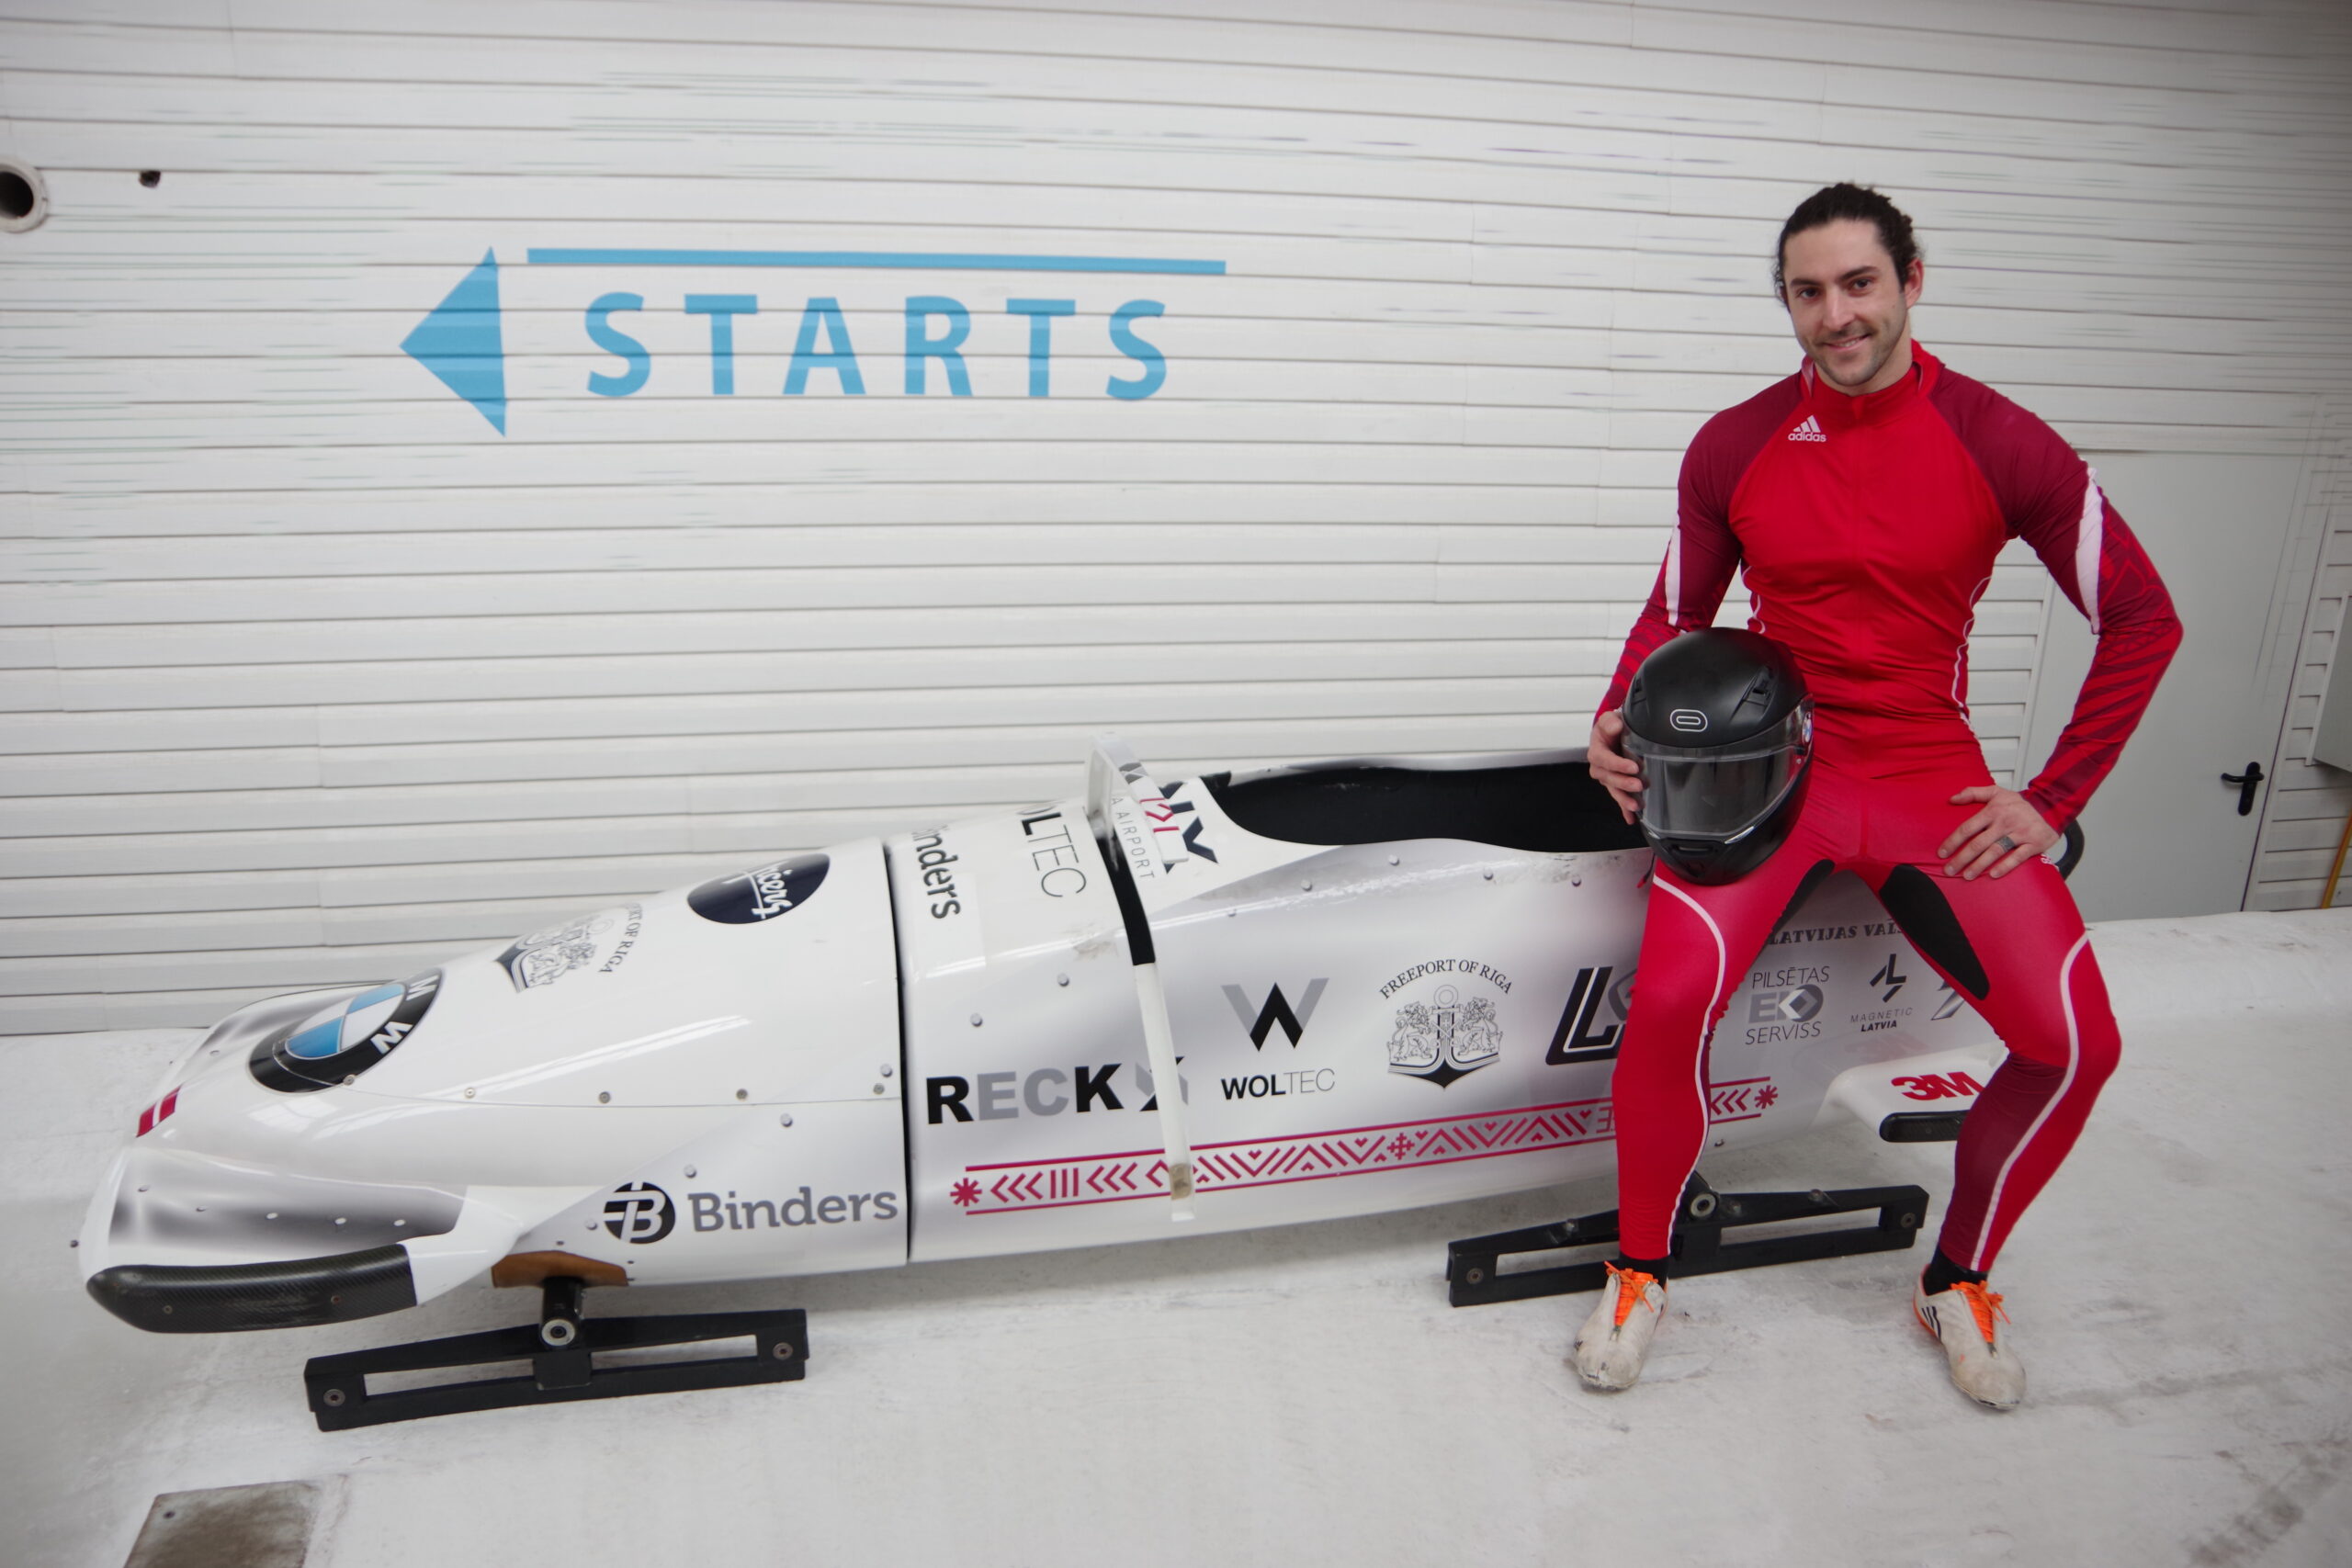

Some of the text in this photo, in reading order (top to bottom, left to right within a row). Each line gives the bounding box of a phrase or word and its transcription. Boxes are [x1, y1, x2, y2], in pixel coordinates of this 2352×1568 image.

[585, 291, 1167, 400] STARTS
[1788, 432, 1826, 442] adidas
[1115, 811, 1156, 879] AIRPORT
[1769, 922, 1903, 944] LATVIJAS VAL
[598, 940, 634, 973] RIGA
[1379, 959, 1512, 999] FREEPORT OF RIGA
[1752, 965, 1830, 989] PILSĒTAS
[1850, 1008, 1913, 1023] MAGNETIC
[1860, 1020, 1898, 1032] LATVIA
[1746, 1021, 1822, 1044] SERVISS
[1221, 1068, 1335, 1100] WOLTEC
[1891, 1071, 1984, 1100] 3M
[688, 1187, 899, 1232] Binders
